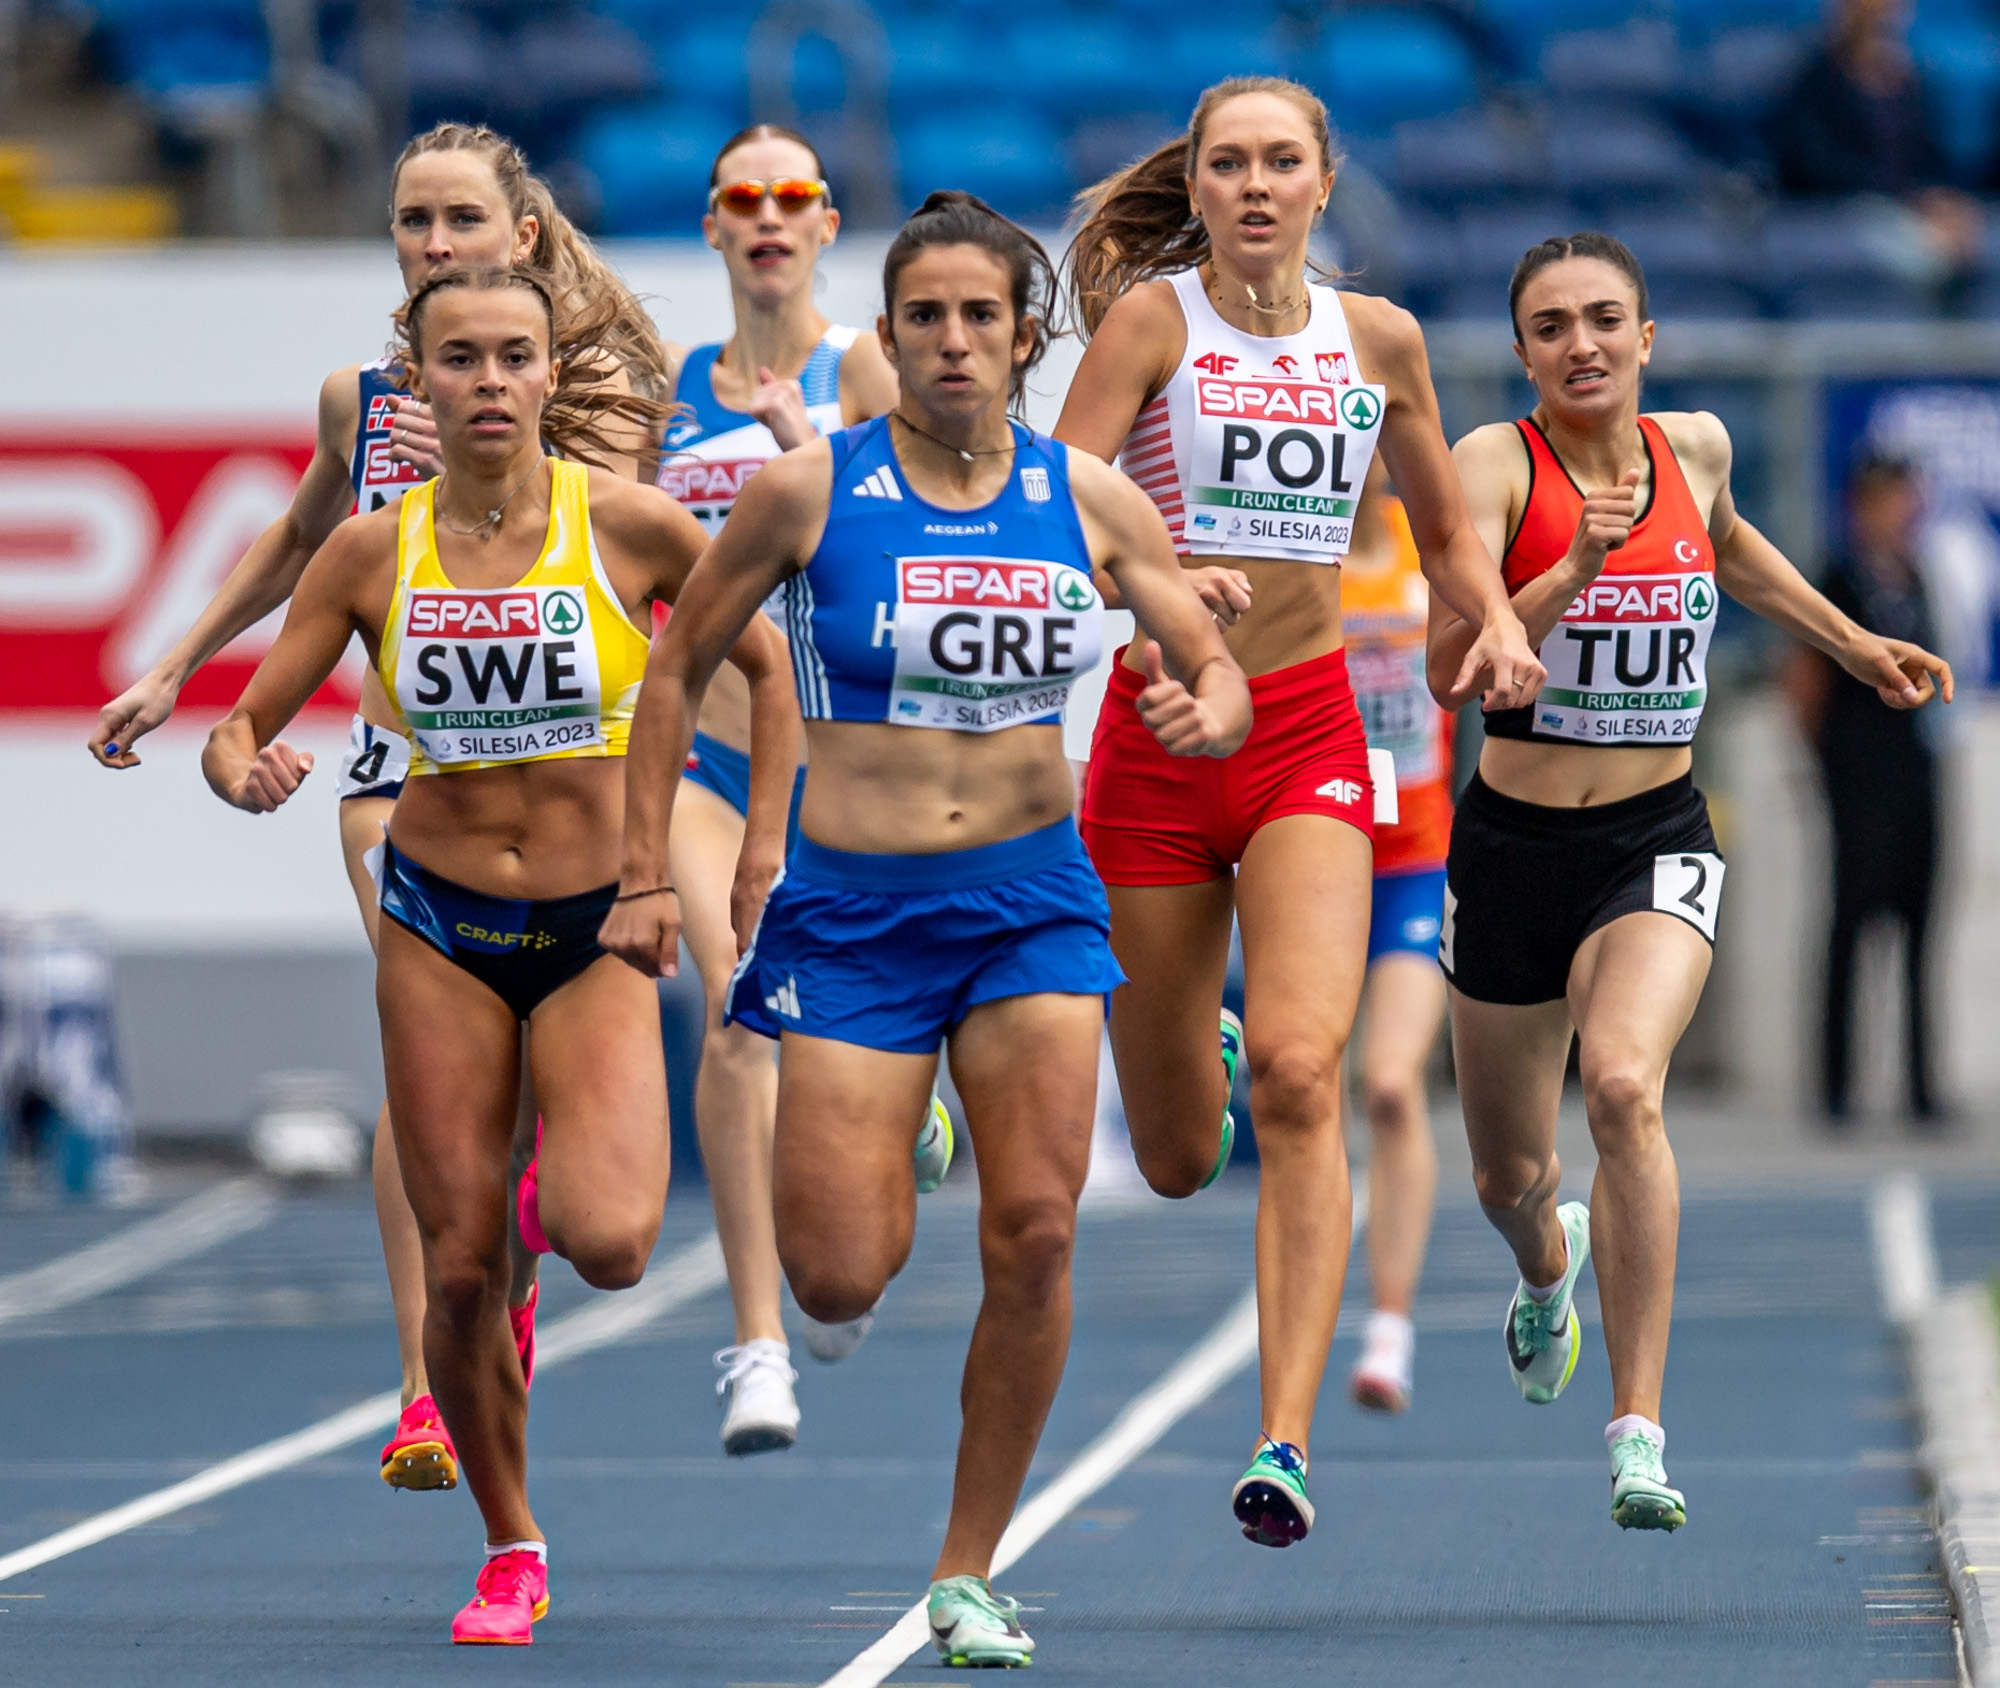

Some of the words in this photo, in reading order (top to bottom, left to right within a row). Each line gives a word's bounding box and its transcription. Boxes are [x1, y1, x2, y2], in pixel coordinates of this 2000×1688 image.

[1193, 352, 1240, 376] 4F
[1202, 382, 1334, 420] SPAR
[1219, 424, 1353, 494] POL
[1231, 491, 1237, 506] I
[1241, 492, 1279, 509] RUN
[1282, 496, 1334, 514] CLEAN
[923, 524, 986, 536] AEGEAN
[1249, 519, 1322, 541] SILESIA
[1324, 525, 1349, 544] 2023
[905, 566, 1046, 603] SPAR
[411, 598, 536, 633] SPAR
[929, 611, 1076, 678] GRE
[1565, 628, 1697, 688] TUR
[415, 641, 583, 706] SWE
[951, 682, 988, 698] RUN
[1578, 695, 1583, 706] I
[1587, 695, 1620, 709] RUN
[1627, 694, 1683, 708] CLEAN
[436, 713, 442, 727] I
[446, 712, 486, 727] RUN
[490, 708, 550, 727] CLEAN
[957, 699, 1025, 726] SILESIA
[1028, 687, 1068, 713] 2023
[459, 733, 540, 755] SILESIA
[544, 722, 595, 748] 2023
[1596, 719, 1667, 737] SILESIA
[1315, 778, 1363, 806] 4F
[1678, 856, 1708, 917] 2
[456, 922, 534, 947] CRAFT
